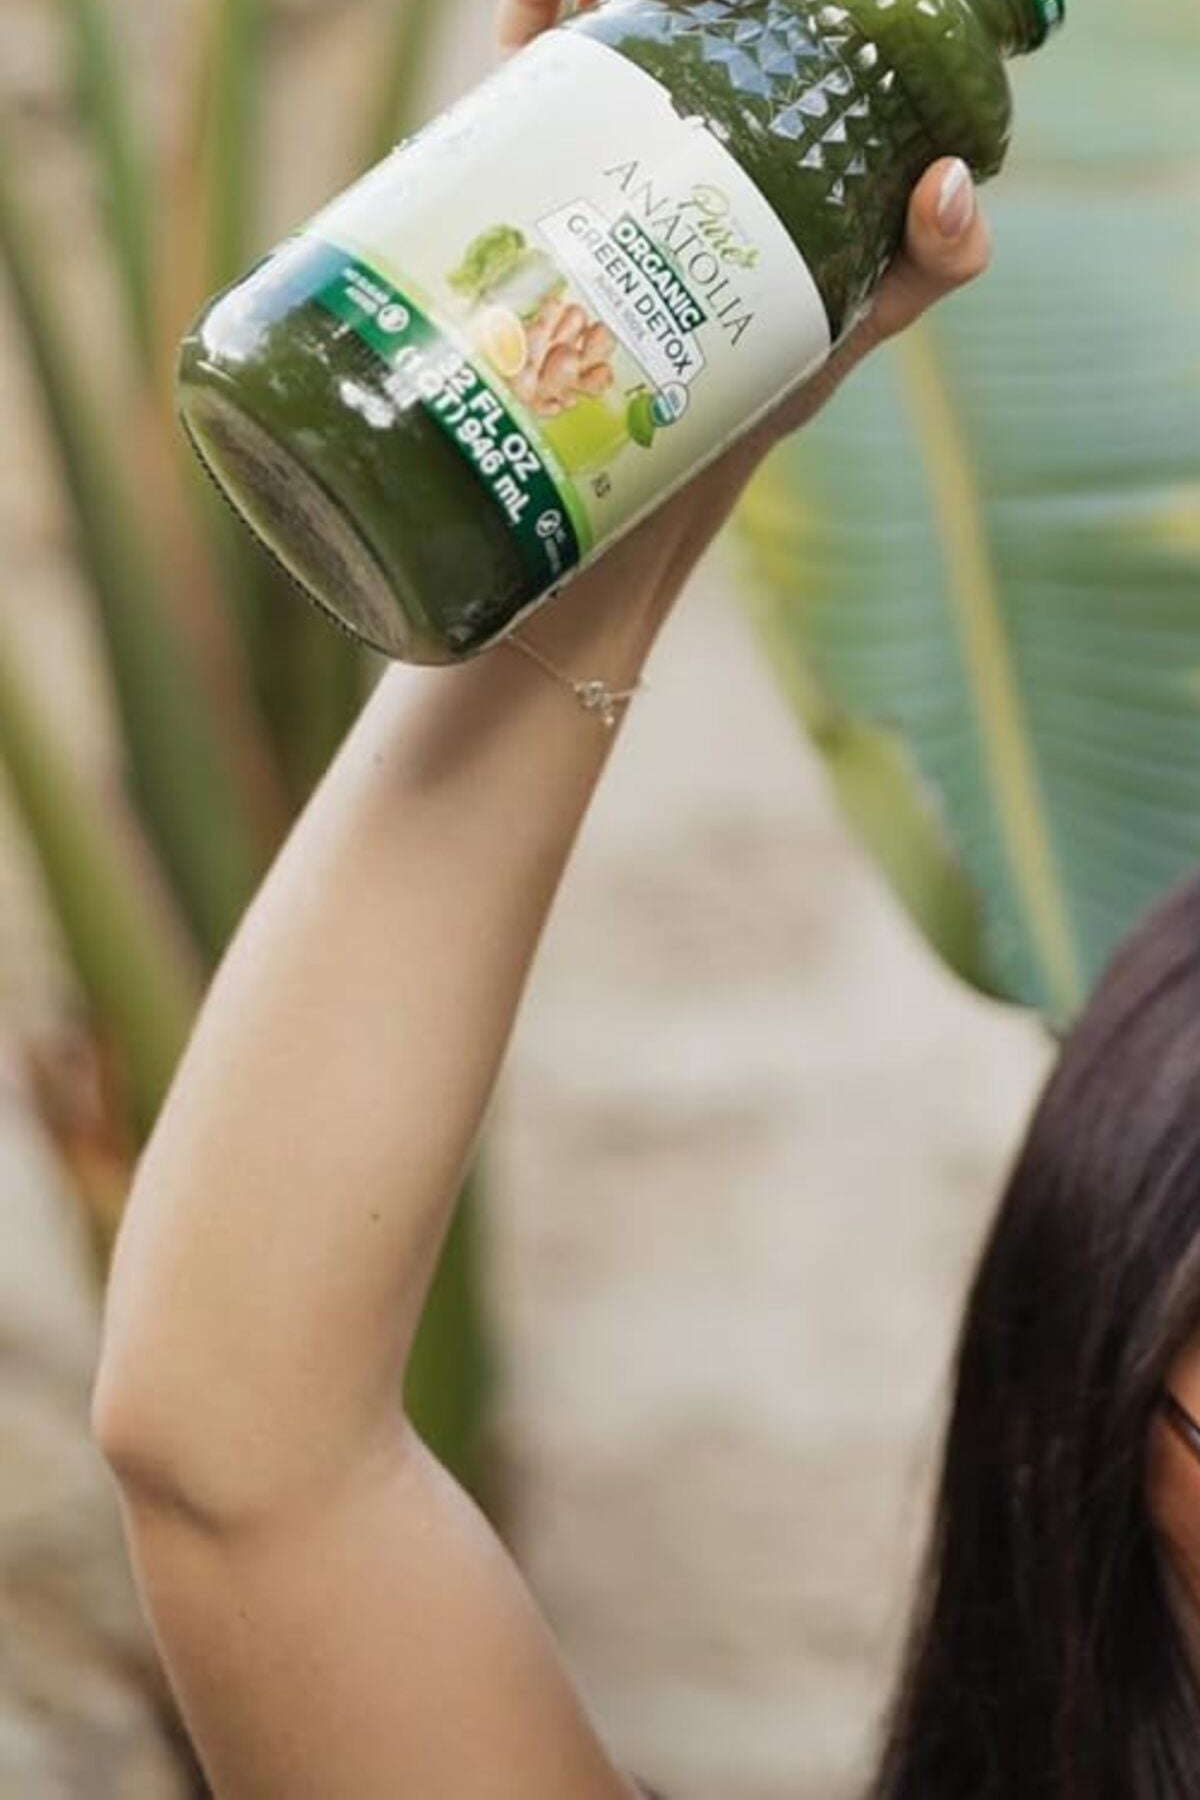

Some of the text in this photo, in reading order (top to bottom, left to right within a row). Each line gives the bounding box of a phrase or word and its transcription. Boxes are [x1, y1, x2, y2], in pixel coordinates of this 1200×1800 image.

[567, 214, 693, 375] GREEN DETOX
[603, 160, 755, 346] ANATOLIA
[614, 220, 702, 331] ORGANIC
[456, 418, 504, 475] 946
[493, 475, 530, 524] mL
[469, 389, 504, 436] FL
[502, 433, 541, 481] OZ
